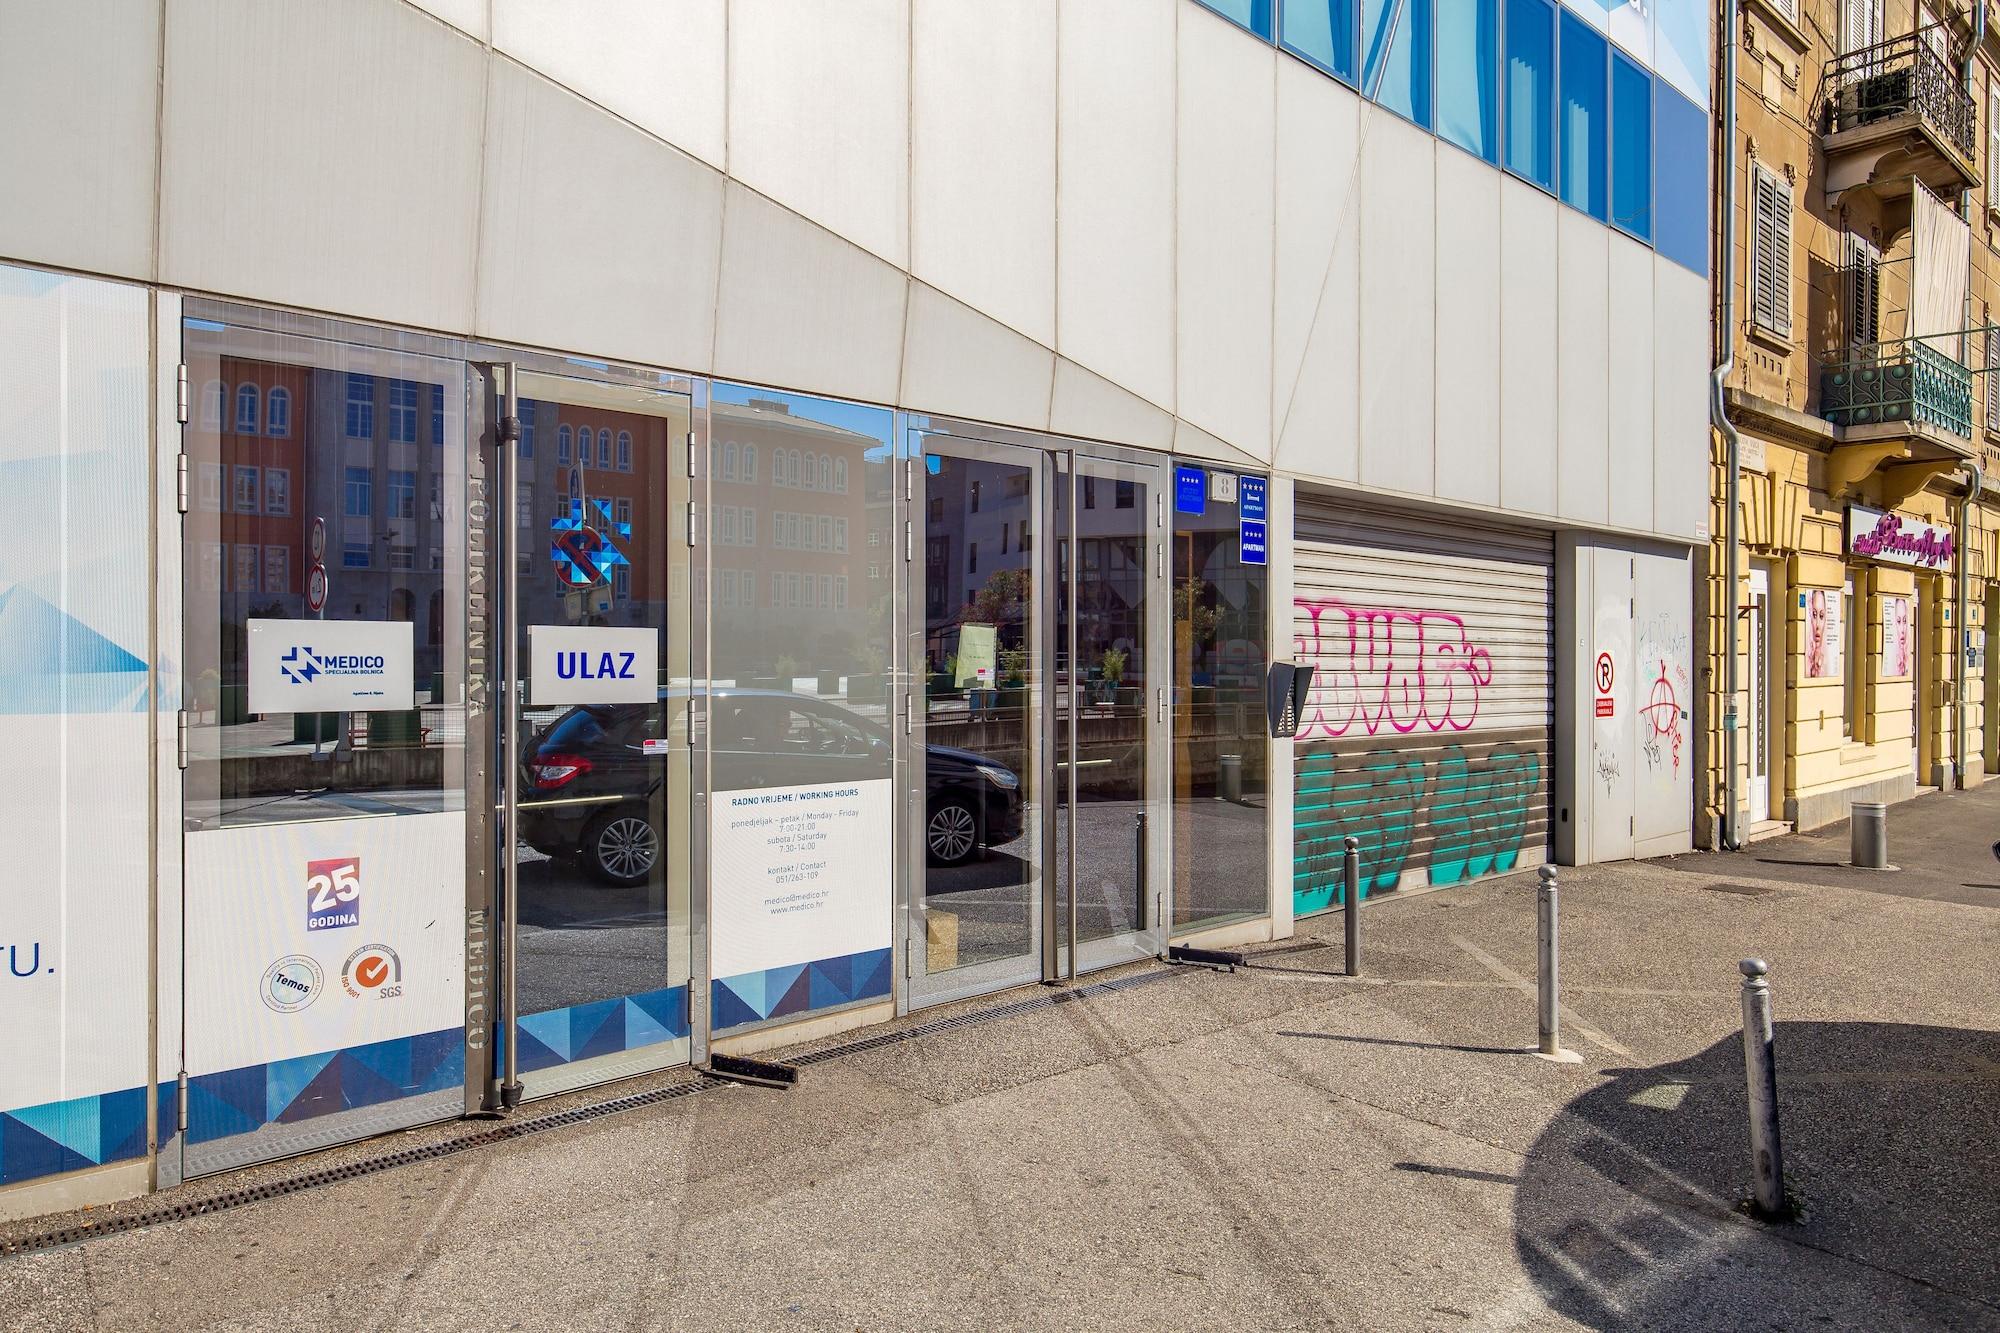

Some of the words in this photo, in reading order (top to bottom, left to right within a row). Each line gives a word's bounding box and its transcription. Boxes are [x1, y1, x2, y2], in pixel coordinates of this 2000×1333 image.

[1221, 478, 1229, 494] 8
[1243, 543, 1265, 553] APARTMAN
[468, 474, 489, 719] POLIKLINIKA
[324, 655, 384, 669] MEDICO
[557, 651, 636, 680] ULAZ
[731, 796, 759, 807] RADNO
[760, 793, 793, 804] VRIJEME
[799, 790, 834, 800] WORKING
[835, 788, 859, 797] HOURS
[731, 817, 773, 830] ponedjeljak
[780, 814, 800, 825] petak
[806, 811, 833, 821] Monday
[838, 809, 859, 818] Friday
[767, 835, 791, 845] subota
[797, 832, 827, 842] Saturday
[767, 865, 794, 875] kontakt
[800, 861, 827, 871] Contact
[775, 871, 819, 884] 051/263-109
[307, 864, 360, 913] 25
[764, 890, 830, 906] medico@medico.hr
[770, 901, 824, 915] www.medico.hr
[308, 913, 358, 929] GODINA
[0, 942, 54, 977] U.
[275, 973, 310, 993] Temos
[341, 975, 350, 988] ISO
[346, 987, 361, 1000] 9001
[468, 909, 489, 1050] MEDICO
[380, 985, 402, 999] SGS
